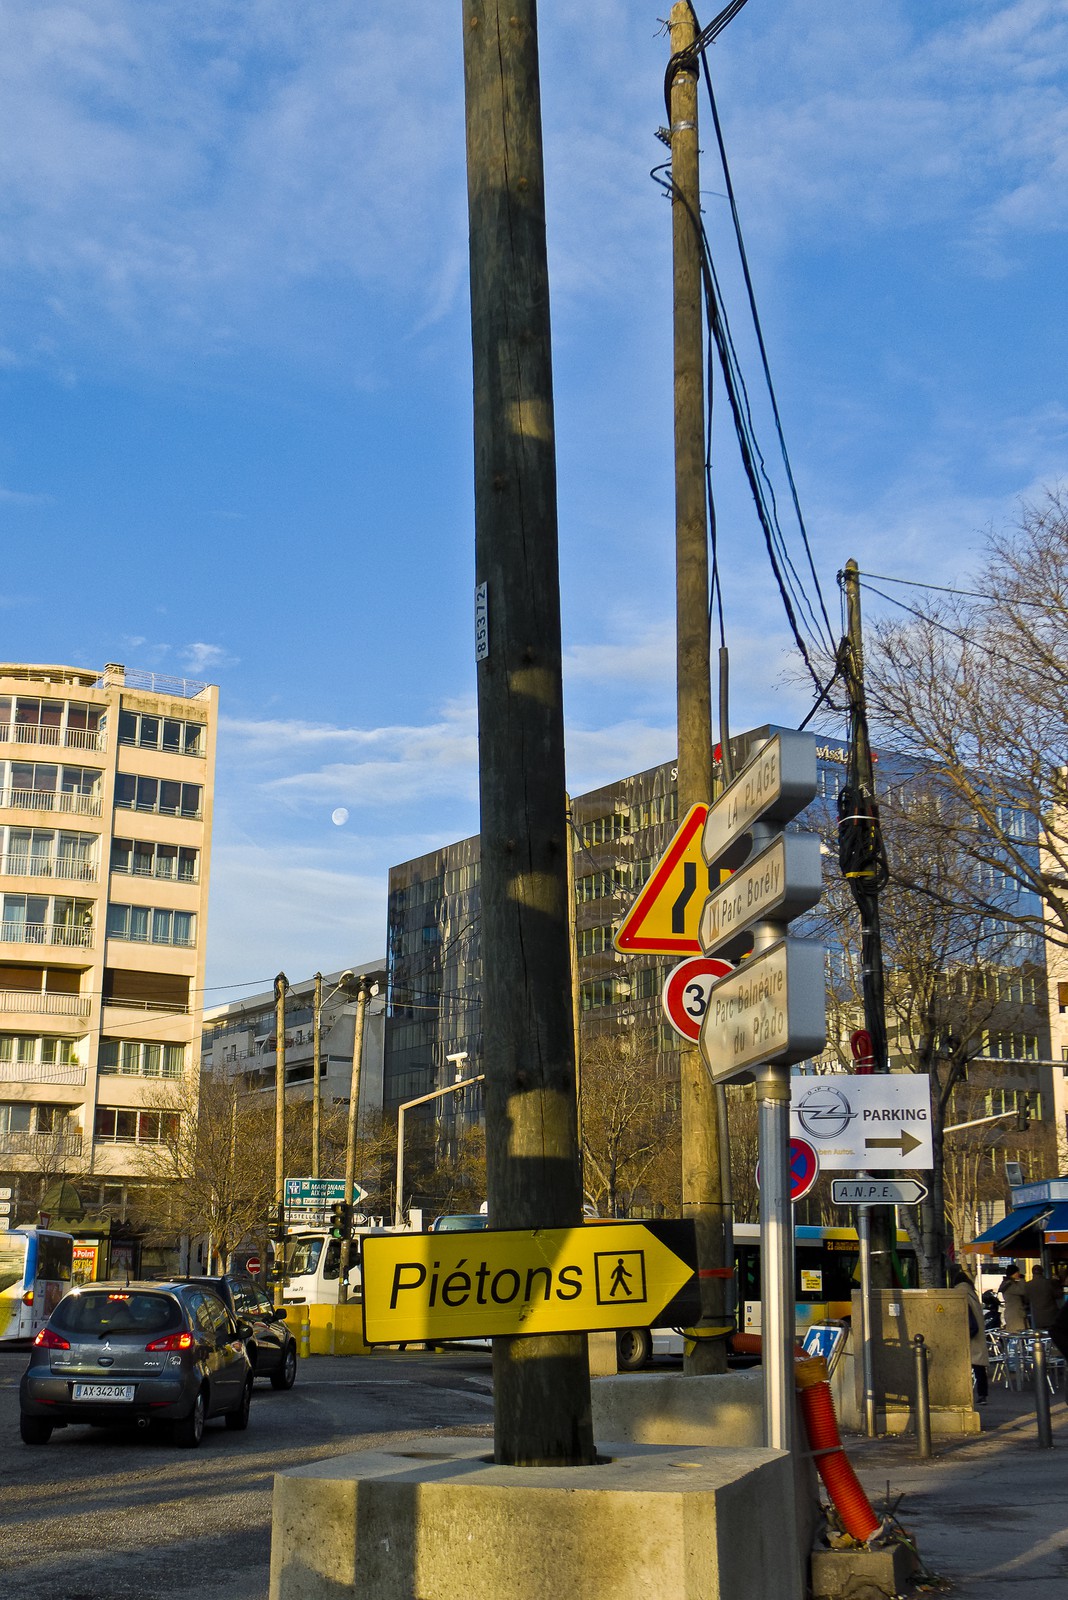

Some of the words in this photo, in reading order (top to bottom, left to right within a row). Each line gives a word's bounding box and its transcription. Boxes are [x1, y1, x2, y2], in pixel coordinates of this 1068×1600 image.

[727, 796, 738, 829] LA
[744, 754, 776, 812] PLAGE
[721, 895, 742, 927] Parc
[747, 861, 780, 907] Borély
[685, 984, 707, 1017] 3
[715, 1000, 734, 1026] Parc
[738, 968, 783, 1013] Balnéaire
[734, 1027, 745, 1054] du
[753, 1007, 784, 1046] Prado
[863, 1109, 927, 1121] PARKING
[840, 1186, 893, 1198] A.N.P.E.
[77, 1250, 95, 1258] Point
[389, 1258, 583, 1310] Piétons
